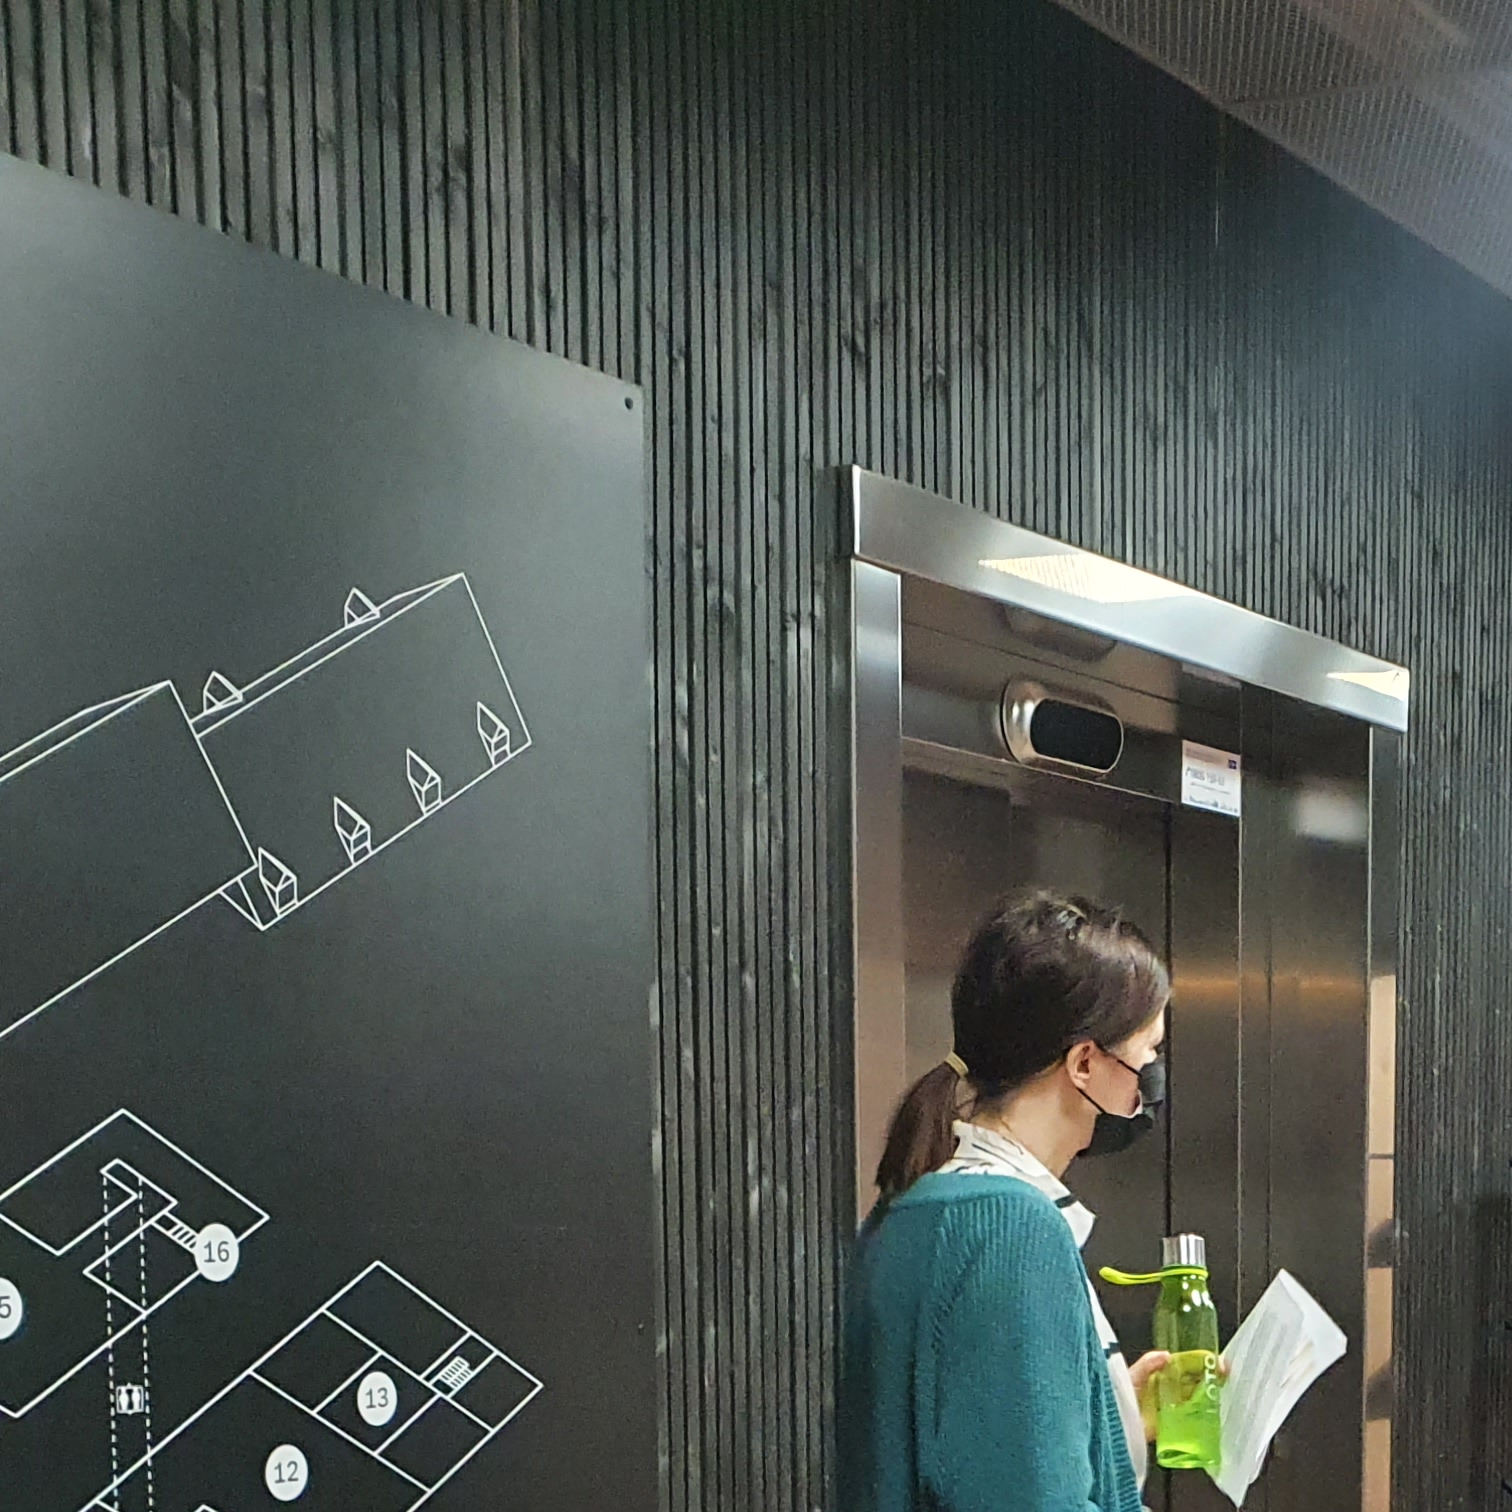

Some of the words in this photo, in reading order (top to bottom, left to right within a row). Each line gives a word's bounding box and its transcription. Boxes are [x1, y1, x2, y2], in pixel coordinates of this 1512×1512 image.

[204, 1241, 229, 1263] 16
[366, 1388, 388, 1409] 13
[274, 1462, 298, 1484] 12
